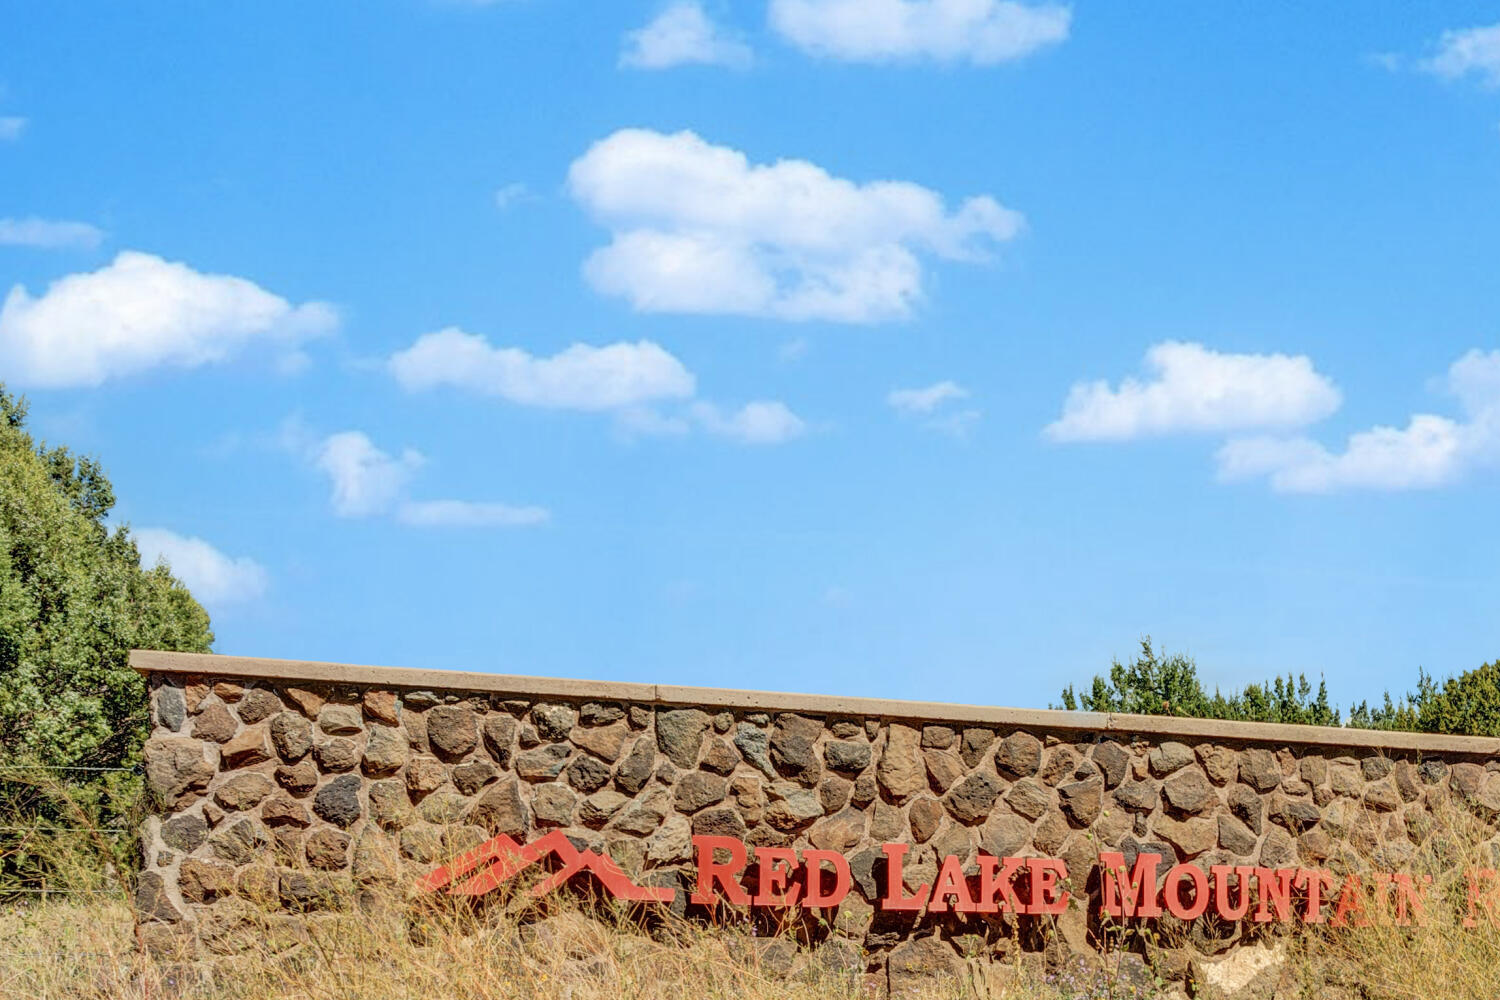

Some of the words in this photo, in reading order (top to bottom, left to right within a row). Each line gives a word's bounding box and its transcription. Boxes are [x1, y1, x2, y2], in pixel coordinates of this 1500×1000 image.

[691, 834, 851, 908] RED
[881, 843, 1068, 915] LAKE
[1100, 852, 1432, 928] MOUNTAIN
